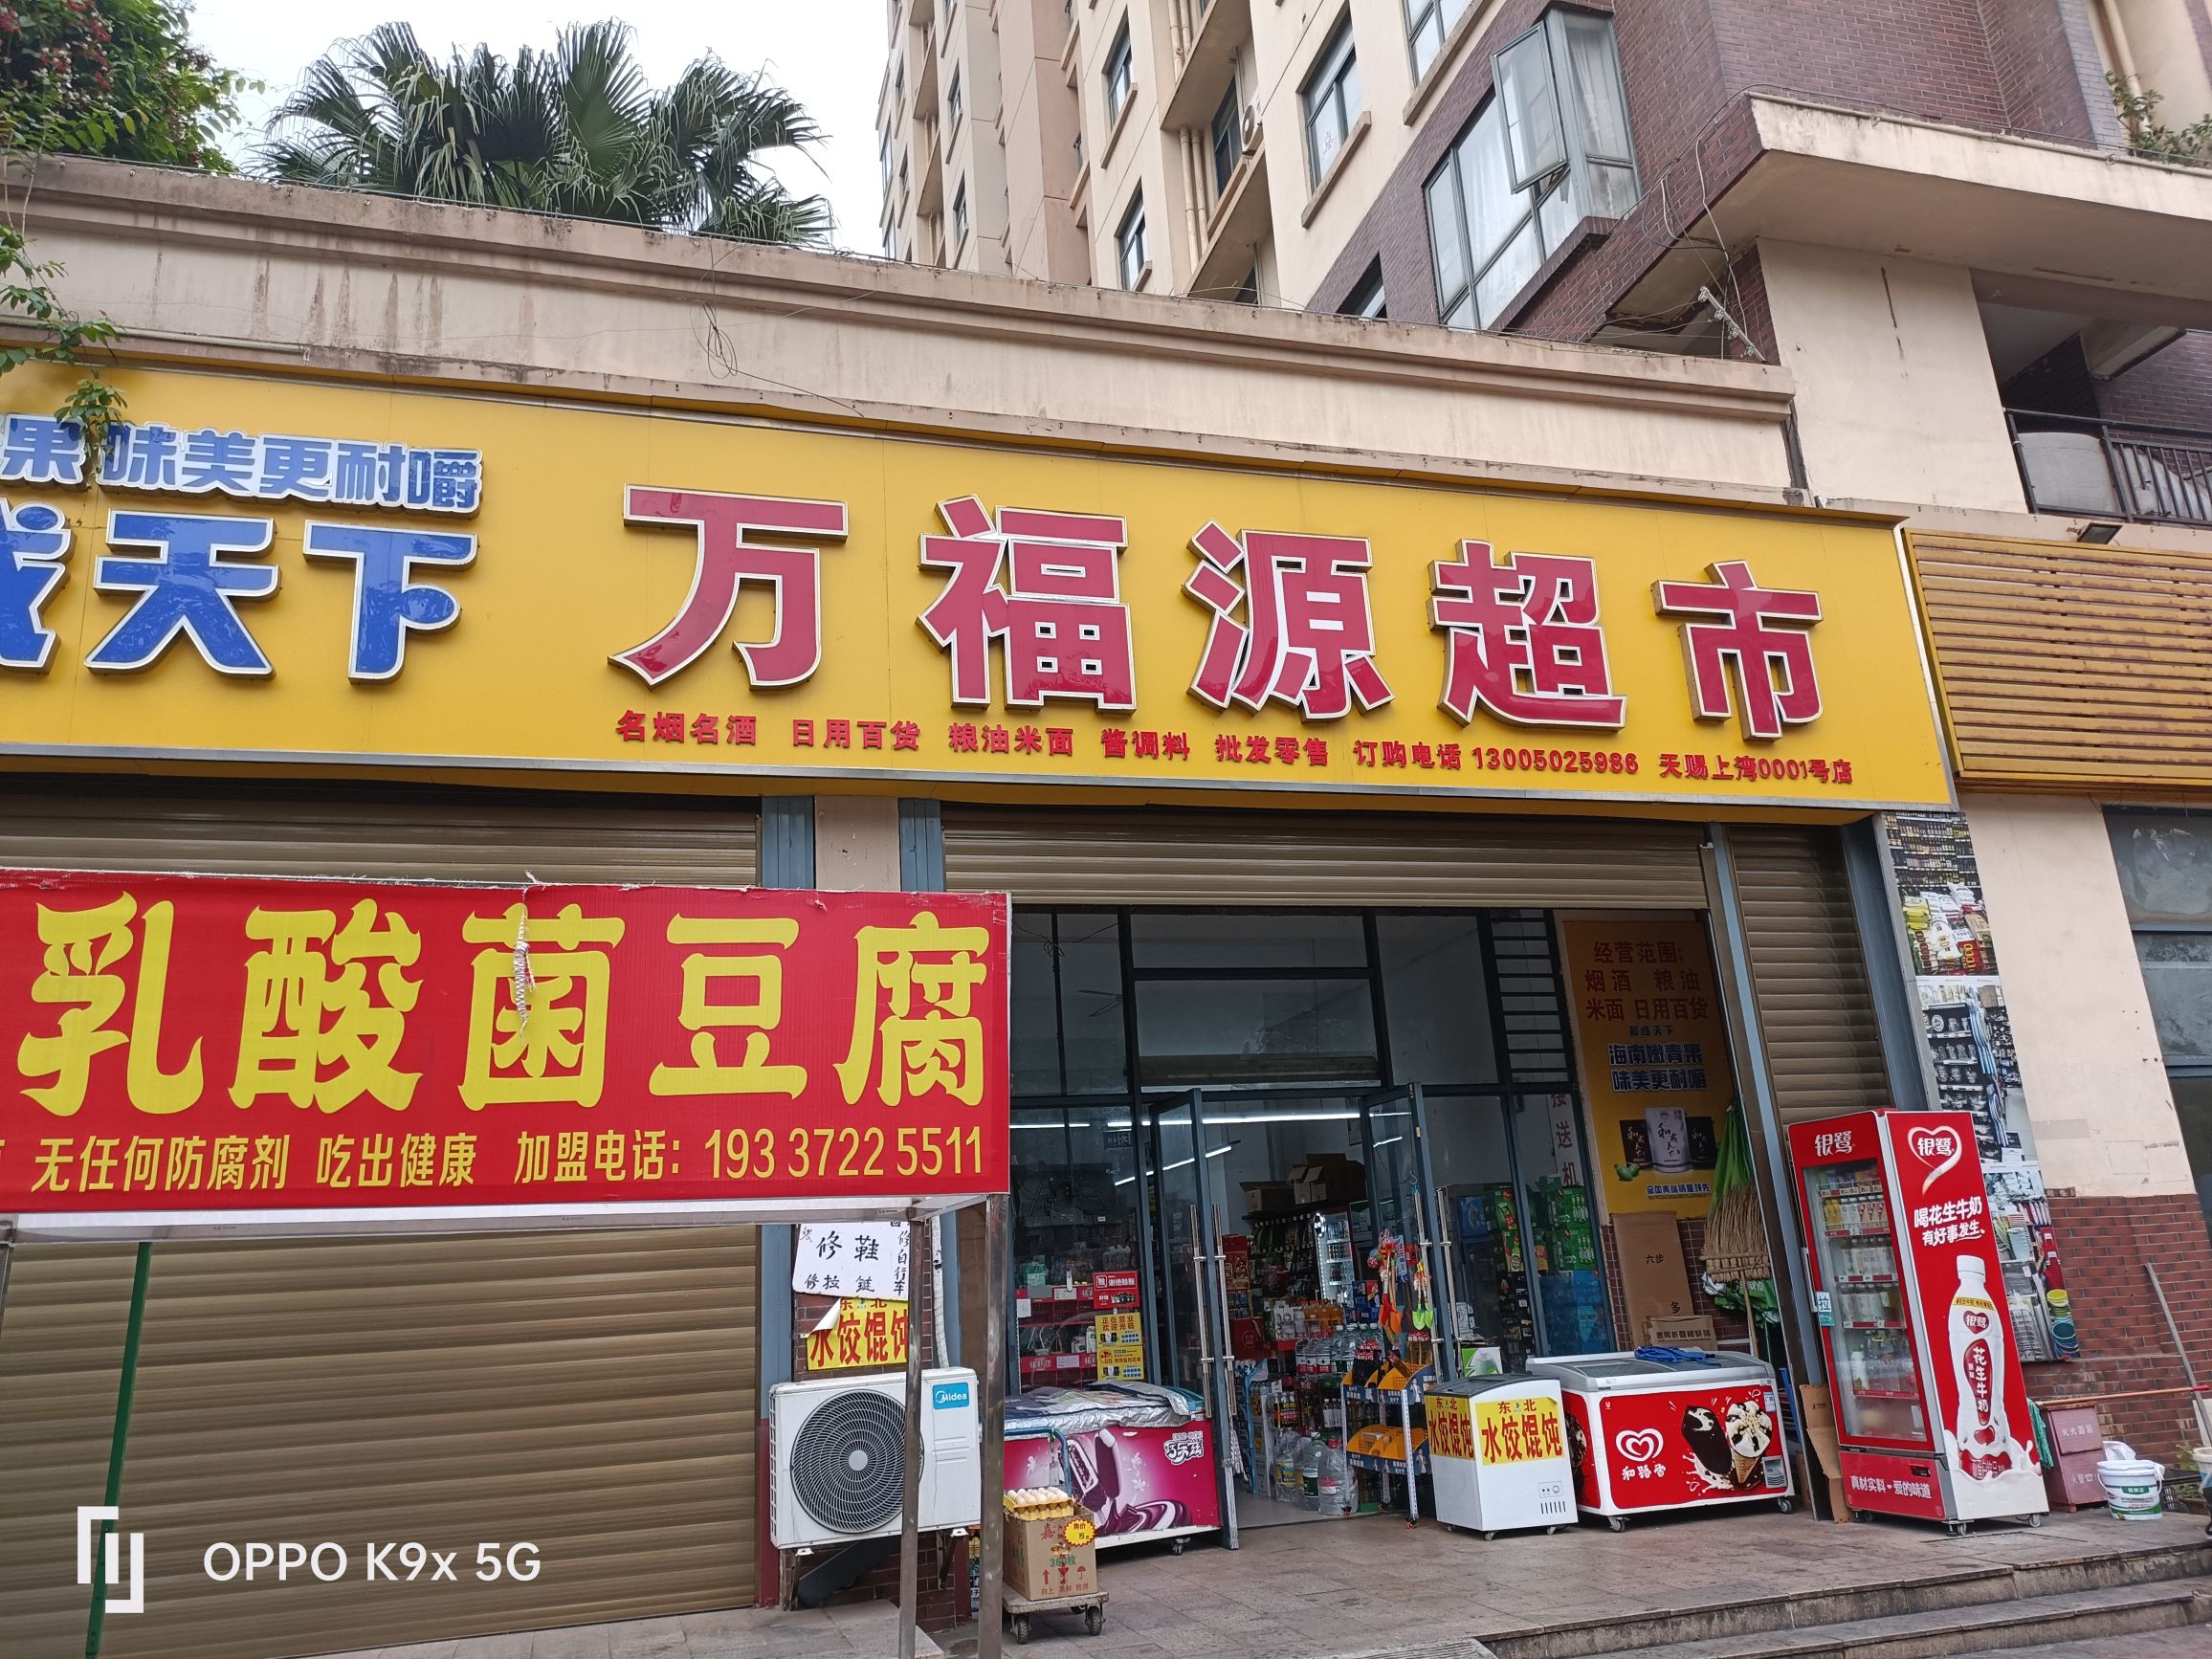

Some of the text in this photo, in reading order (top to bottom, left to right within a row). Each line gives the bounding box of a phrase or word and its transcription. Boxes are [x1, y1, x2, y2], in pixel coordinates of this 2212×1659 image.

[608, 483, 1823, 741] 万福源超市
[615, 709, 1854, 785] 名烟名酒 日用百货 粮油米面 酱调料 批发零售 订购电话 13005025986 天赐上湾0001号店
[1584, 967, 1700, 992] 烟酒 粮油
[18, 891, 989, 1117] 乳酸菌豆腐
[1586, 996, 1709, 1021] 米面 日用百货
[31, 1134, 290, 1193] 无任何防腐剂
[316, 1132, 477, 1188] 吃出健康
[705, 1129, 775, 1179] 193
[789, 1128, 884, 1178] 3722
[897, 1126, 982, 1177] 5511
[1815, 1130, 1853, 1157] 银鹭
[1917, 1138, 1953, 1157] 银鹭
[1913, 1196, 1982, 1228] 喝花生牛奶
[1973, 1346, 1989, 1413] 花生牛奶
[938, 1391, 967, 1404] Midea
[1428, 1409, 1474, 1459] 水饺馄饨
[1482, 1411, 1562, 1464] 水饺馄饨
[1622, 1464, 1666, 1481] 和路雪
[1850, 1474, 1932, 1499] 真材实料 爱的味道
